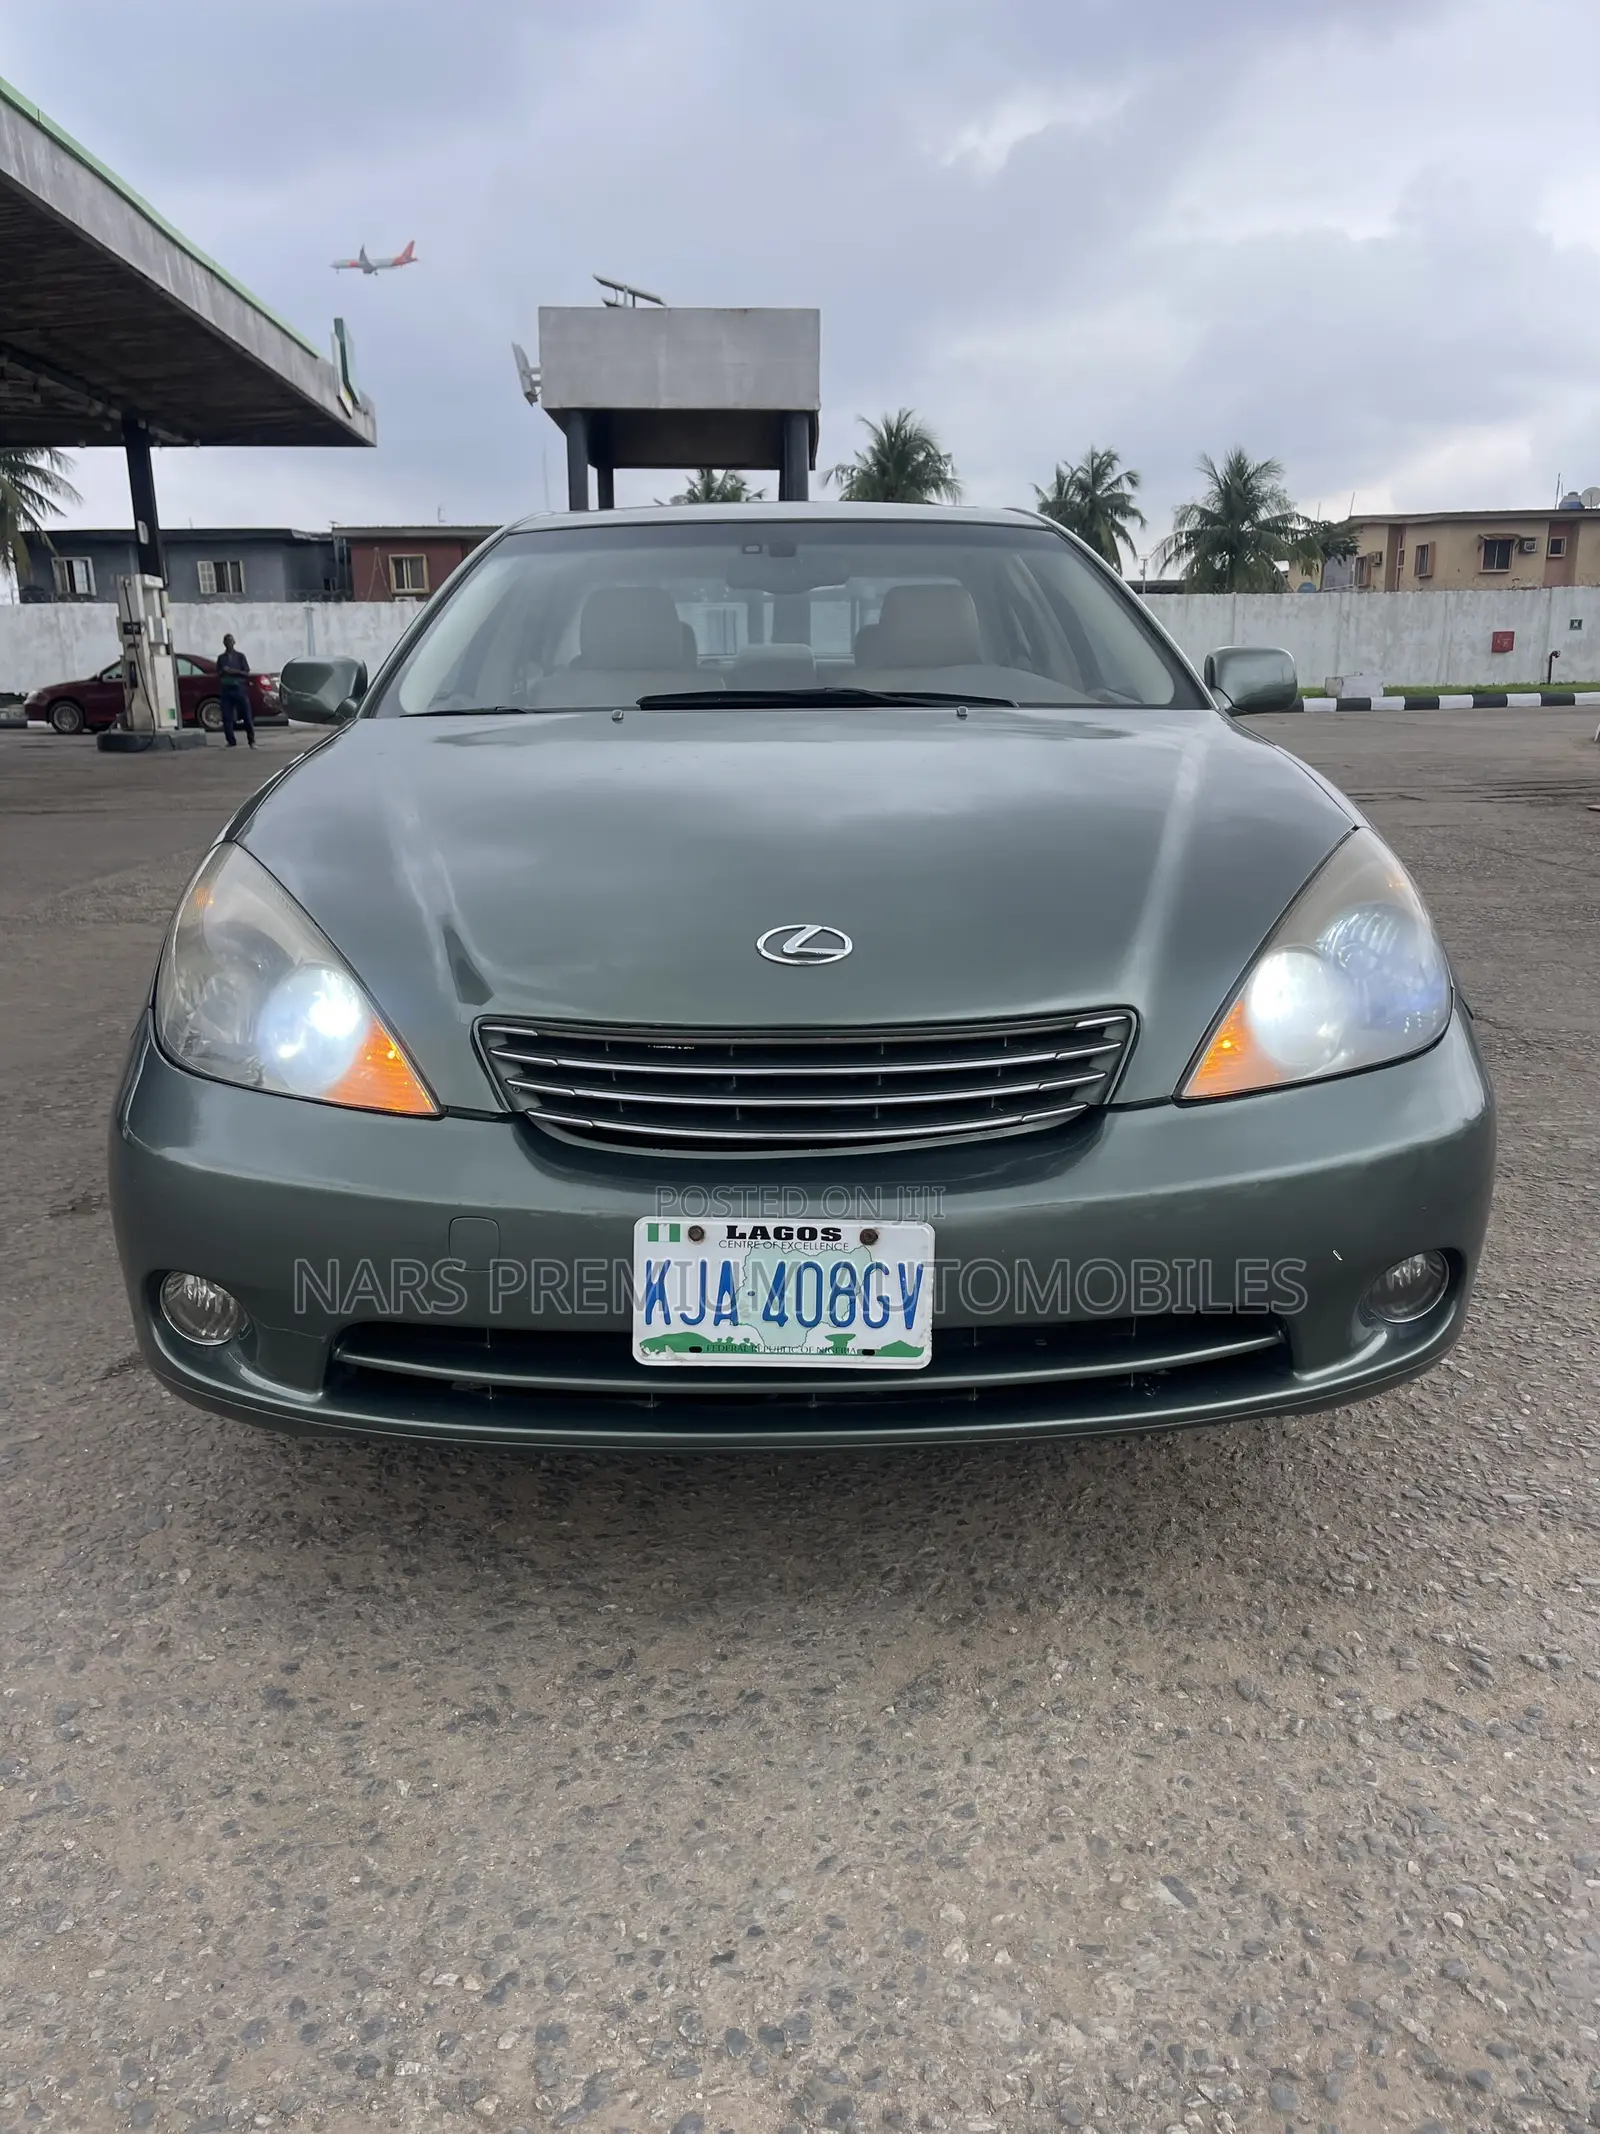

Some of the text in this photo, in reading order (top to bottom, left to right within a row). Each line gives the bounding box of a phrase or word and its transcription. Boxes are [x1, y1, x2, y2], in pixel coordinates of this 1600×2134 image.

[726, 1225, 842, 1242] LAGOS
[718, 1239, 849, 1251] CENTRE OF EXCELLENCE
[706, 1345, 856, 1355] FEDERAL REPUBLIC OF NIGERIA
